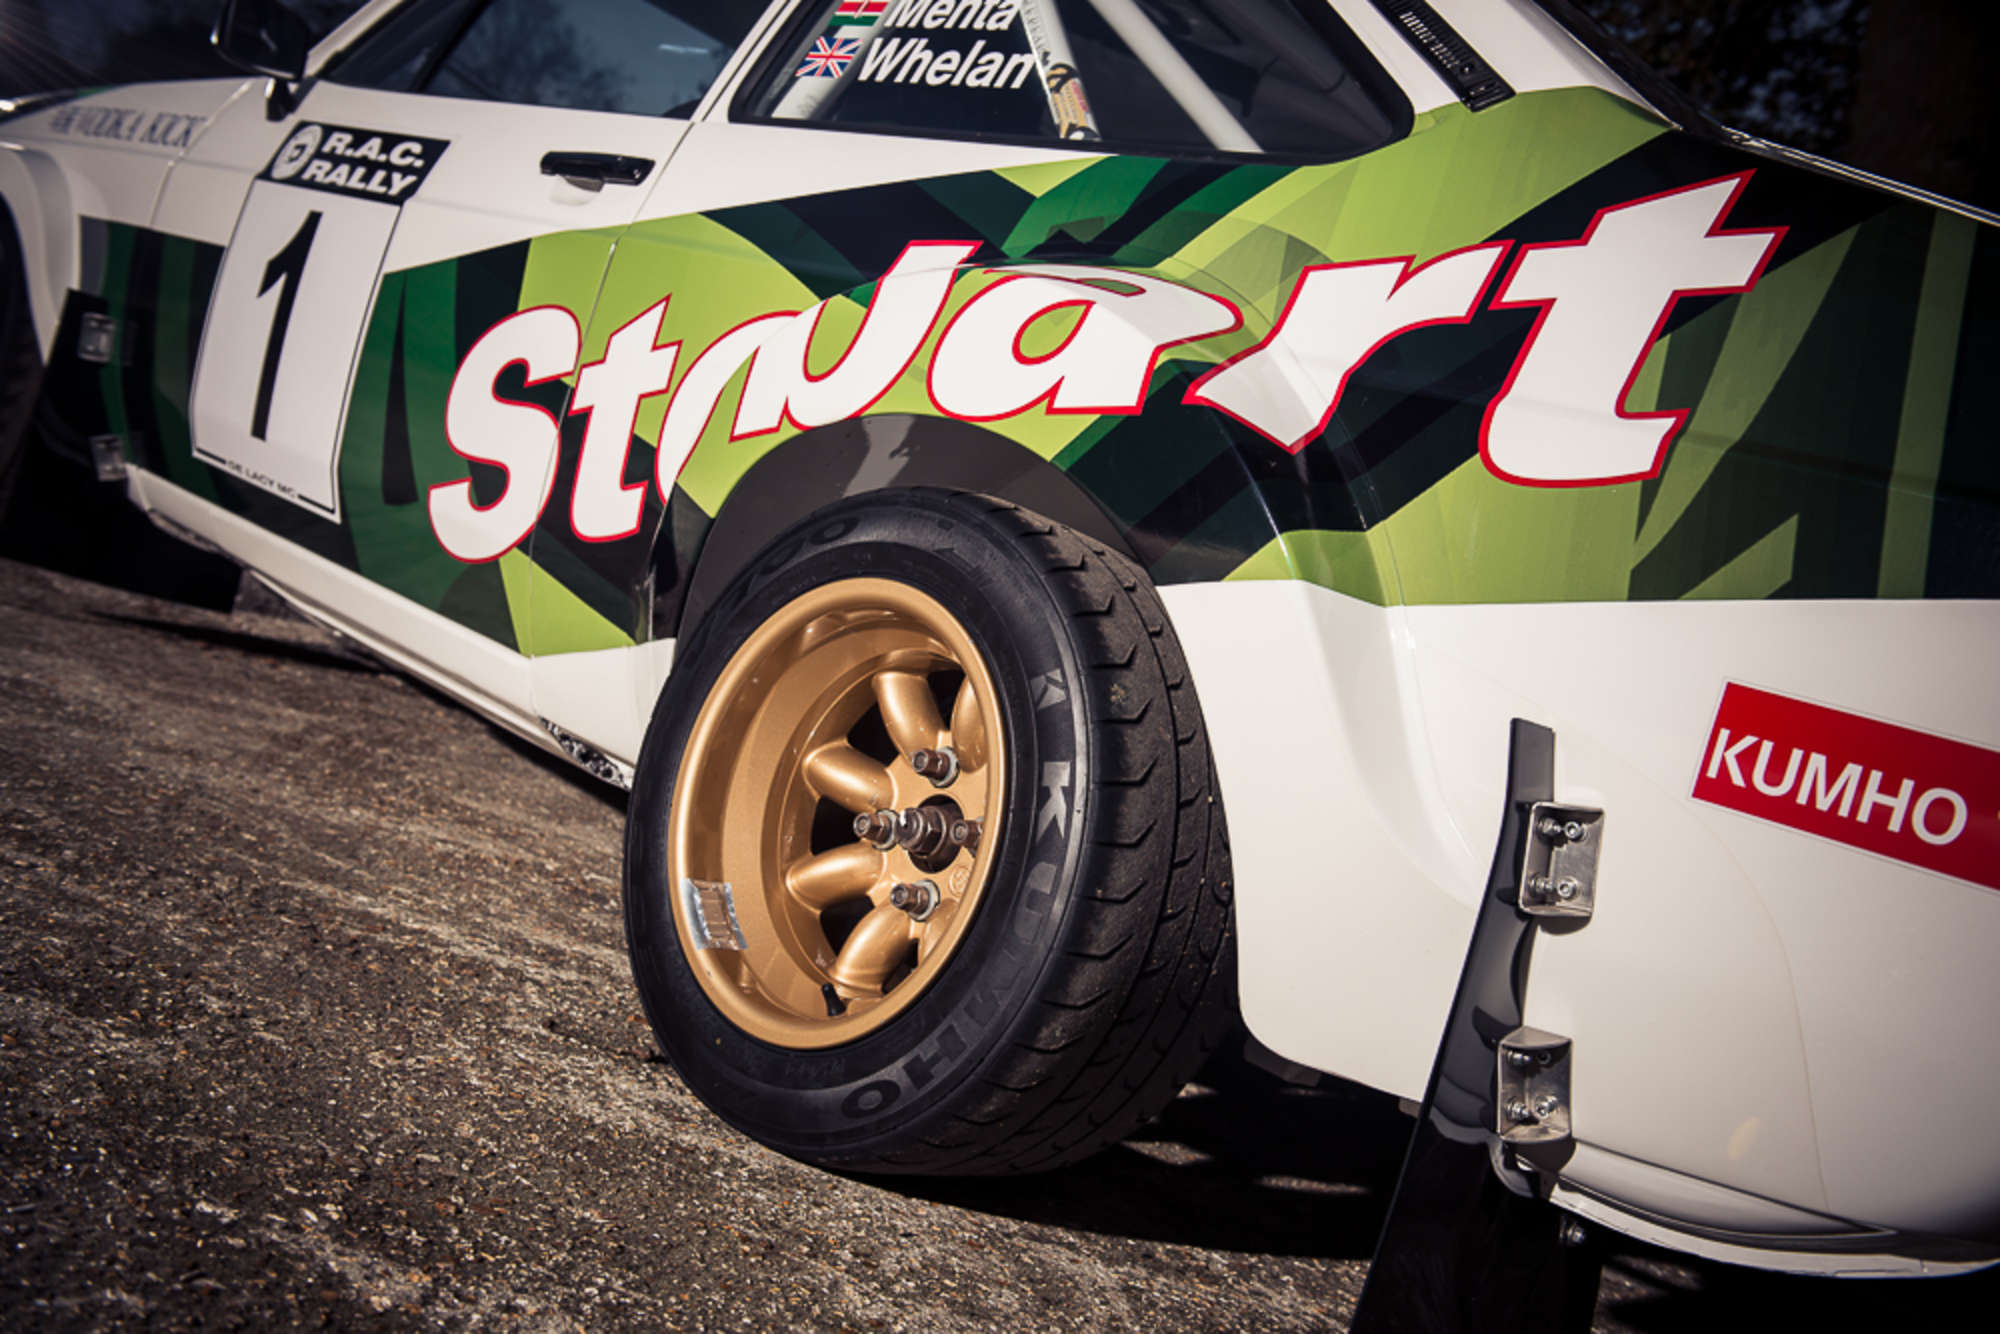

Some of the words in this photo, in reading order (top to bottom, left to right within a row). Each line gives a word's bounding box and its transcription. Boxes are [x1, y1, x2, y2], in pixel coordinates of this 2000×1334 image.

[857, 37, 1036, 89] Whelan
[301, 158, 418, 197] RALLY
[321, 131, 424, 168] R.A.C.
[251, 210, 324, 442] 1
[1706, 727, 1969, 846] KUMHO
[840, 760, 1071, 1120] KUMHO
